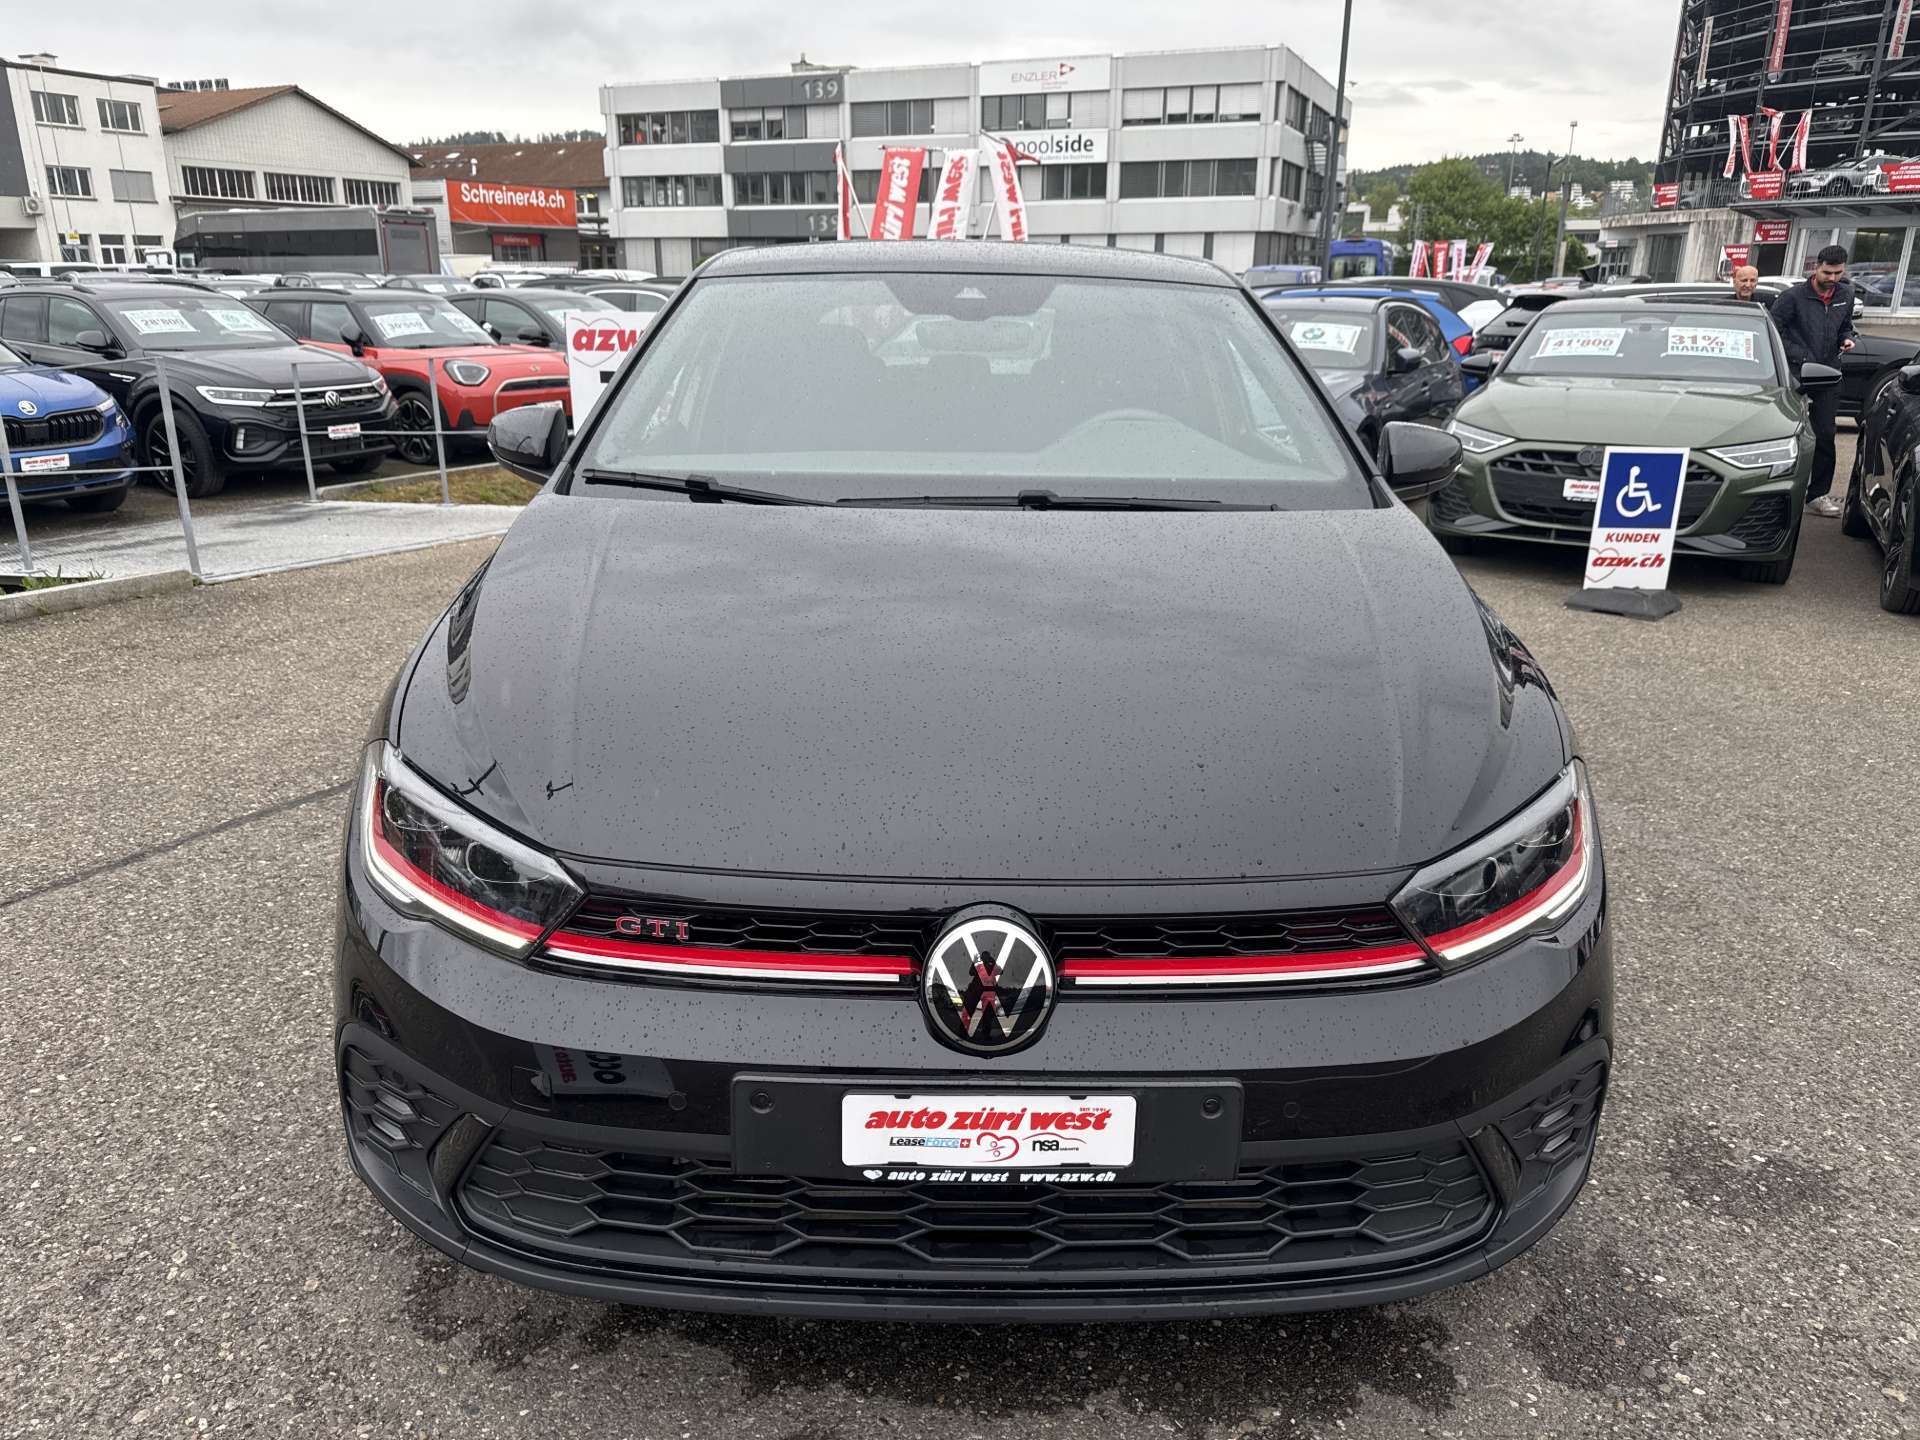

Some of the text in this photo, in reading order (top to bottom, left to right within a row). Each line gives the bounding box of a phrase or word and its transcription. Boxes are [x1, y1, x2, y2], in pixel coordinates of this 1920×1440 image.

[1011, 71, 1058, 83] ENZLER
[803, 80, 838, 99] 139
[888, 156, 911, 203] west
[460, 183, 566, 209] Schreiner48.ch
[1671, 334, 1725, 347] 31%
[1605, 533, 1660, 543] KUNDEN
[1592, 553, 1666, 568] azw.ch
[616, 916, 689, 940] GTI
[864, 1106, 1112, 1131] auto züri west
[889, 1136, 960, 1148] LeaseForce
[1032, 1139, 1060, 1152] nsa
[887, 1169, 1117, 1183] auto züri west www.azw.ch
